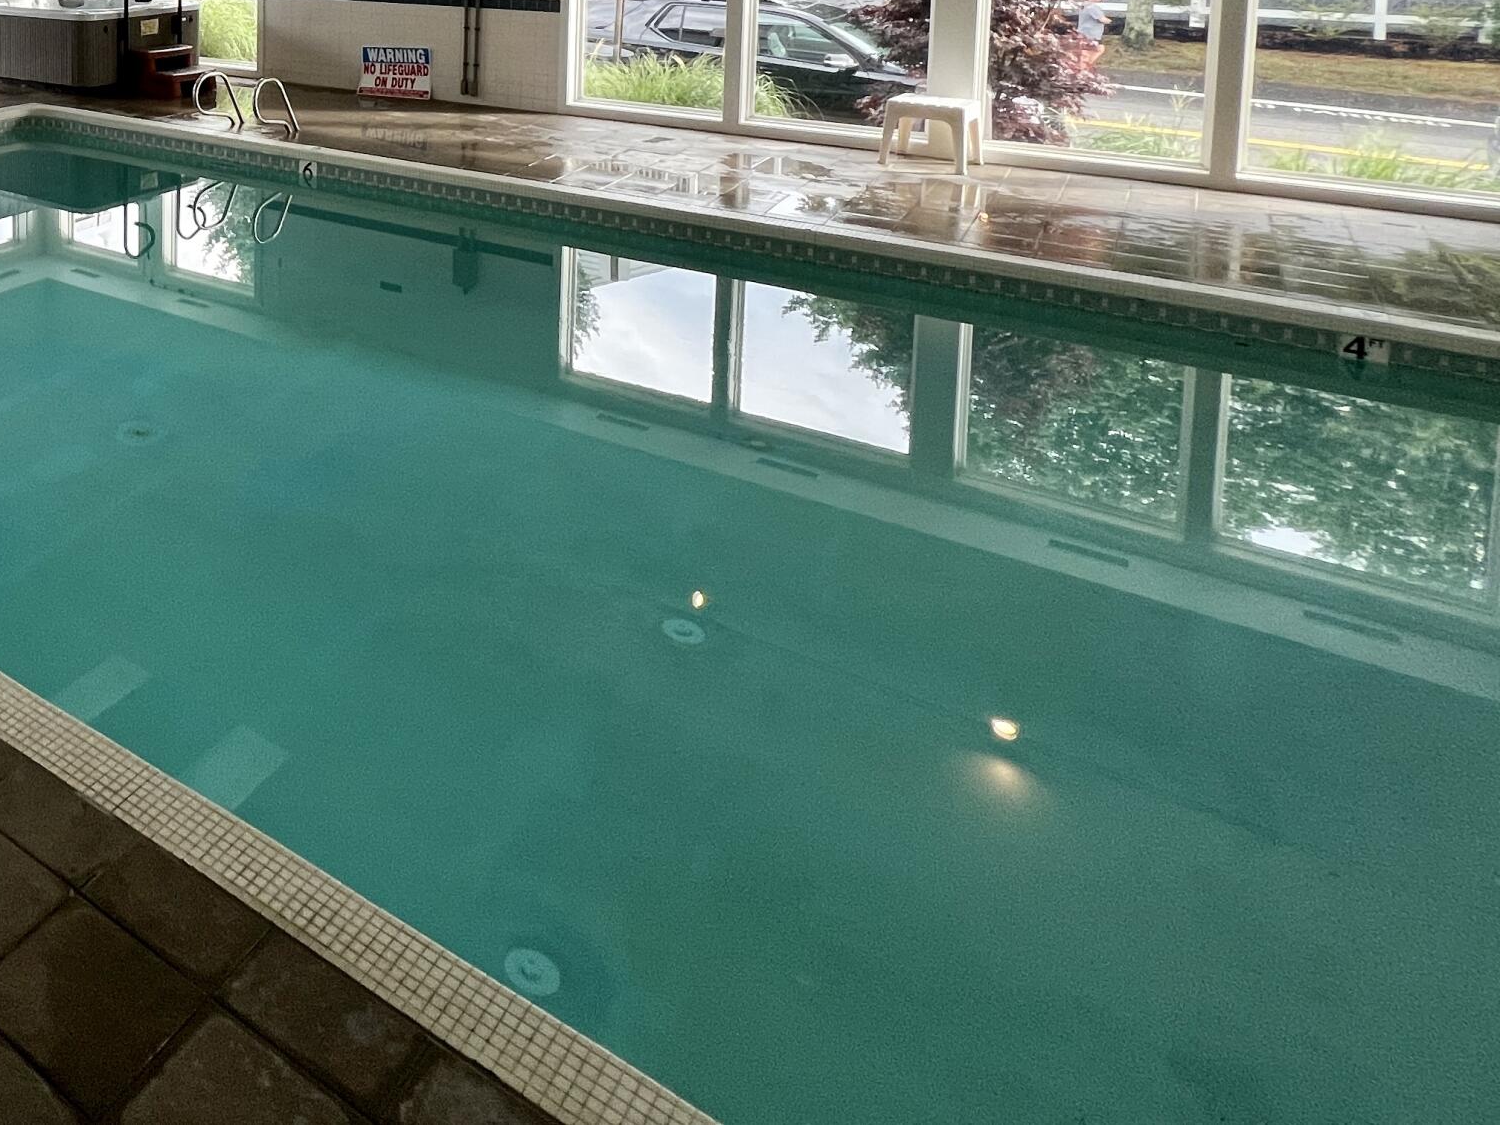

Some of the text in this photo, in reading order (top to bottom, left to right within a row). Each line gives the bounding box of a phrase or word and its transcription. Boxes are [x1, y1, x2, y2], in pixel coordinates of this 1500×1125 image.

[366, 48, 426, 63] WARNING
[363, 63, 429, 76] NO LIFEGUARD
[374, 77, 416, 89] ON DUTY
[1343, 336, 1368, 360] 4
